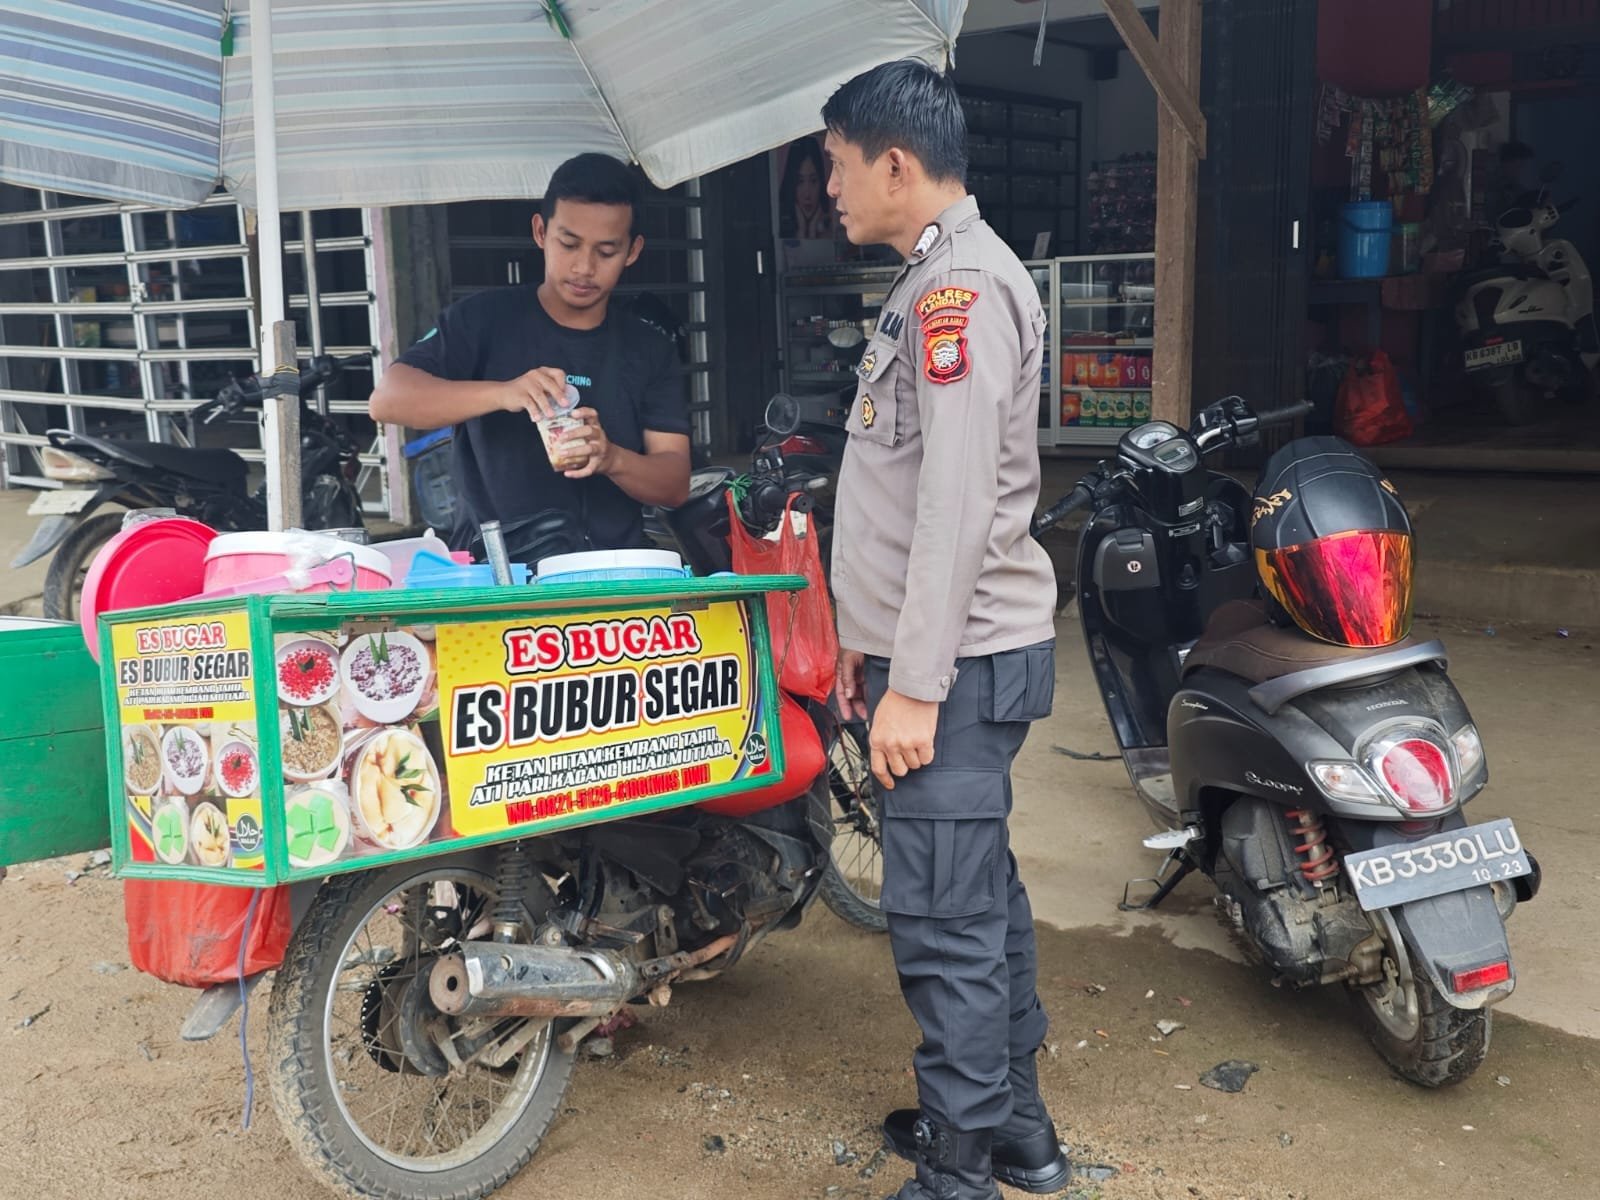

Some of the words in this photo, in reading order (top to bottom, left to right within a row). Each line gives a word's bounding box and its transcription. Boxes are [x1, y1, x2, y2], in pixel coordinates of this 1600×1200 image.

[919, 288, 973, 313] POLRES
[925, 297, 963, 313] LANDAK
[137, 631, 160, 651] ES
[161, 625, 225, 649] BUGAR
[508, 630, 562, 668] ES
[569, 619, 698, 661] BUGAR
[120, 659, 140, 684] ES
[142, 656, 190, 683] BUBUR
[192, 651, 250, 681] SEGAR
[455, 689, 503, 749] ES
[512, 672, 637, 741] BUBUR
[645, 658, 739, 720] SEGAR
[1365, 699, 1409, 711] HONDA
[487, 757, 546, 784] KETAN
[1244, 770, 1304, 796] Scoopy
[470, 783, 503, 806] ATI
